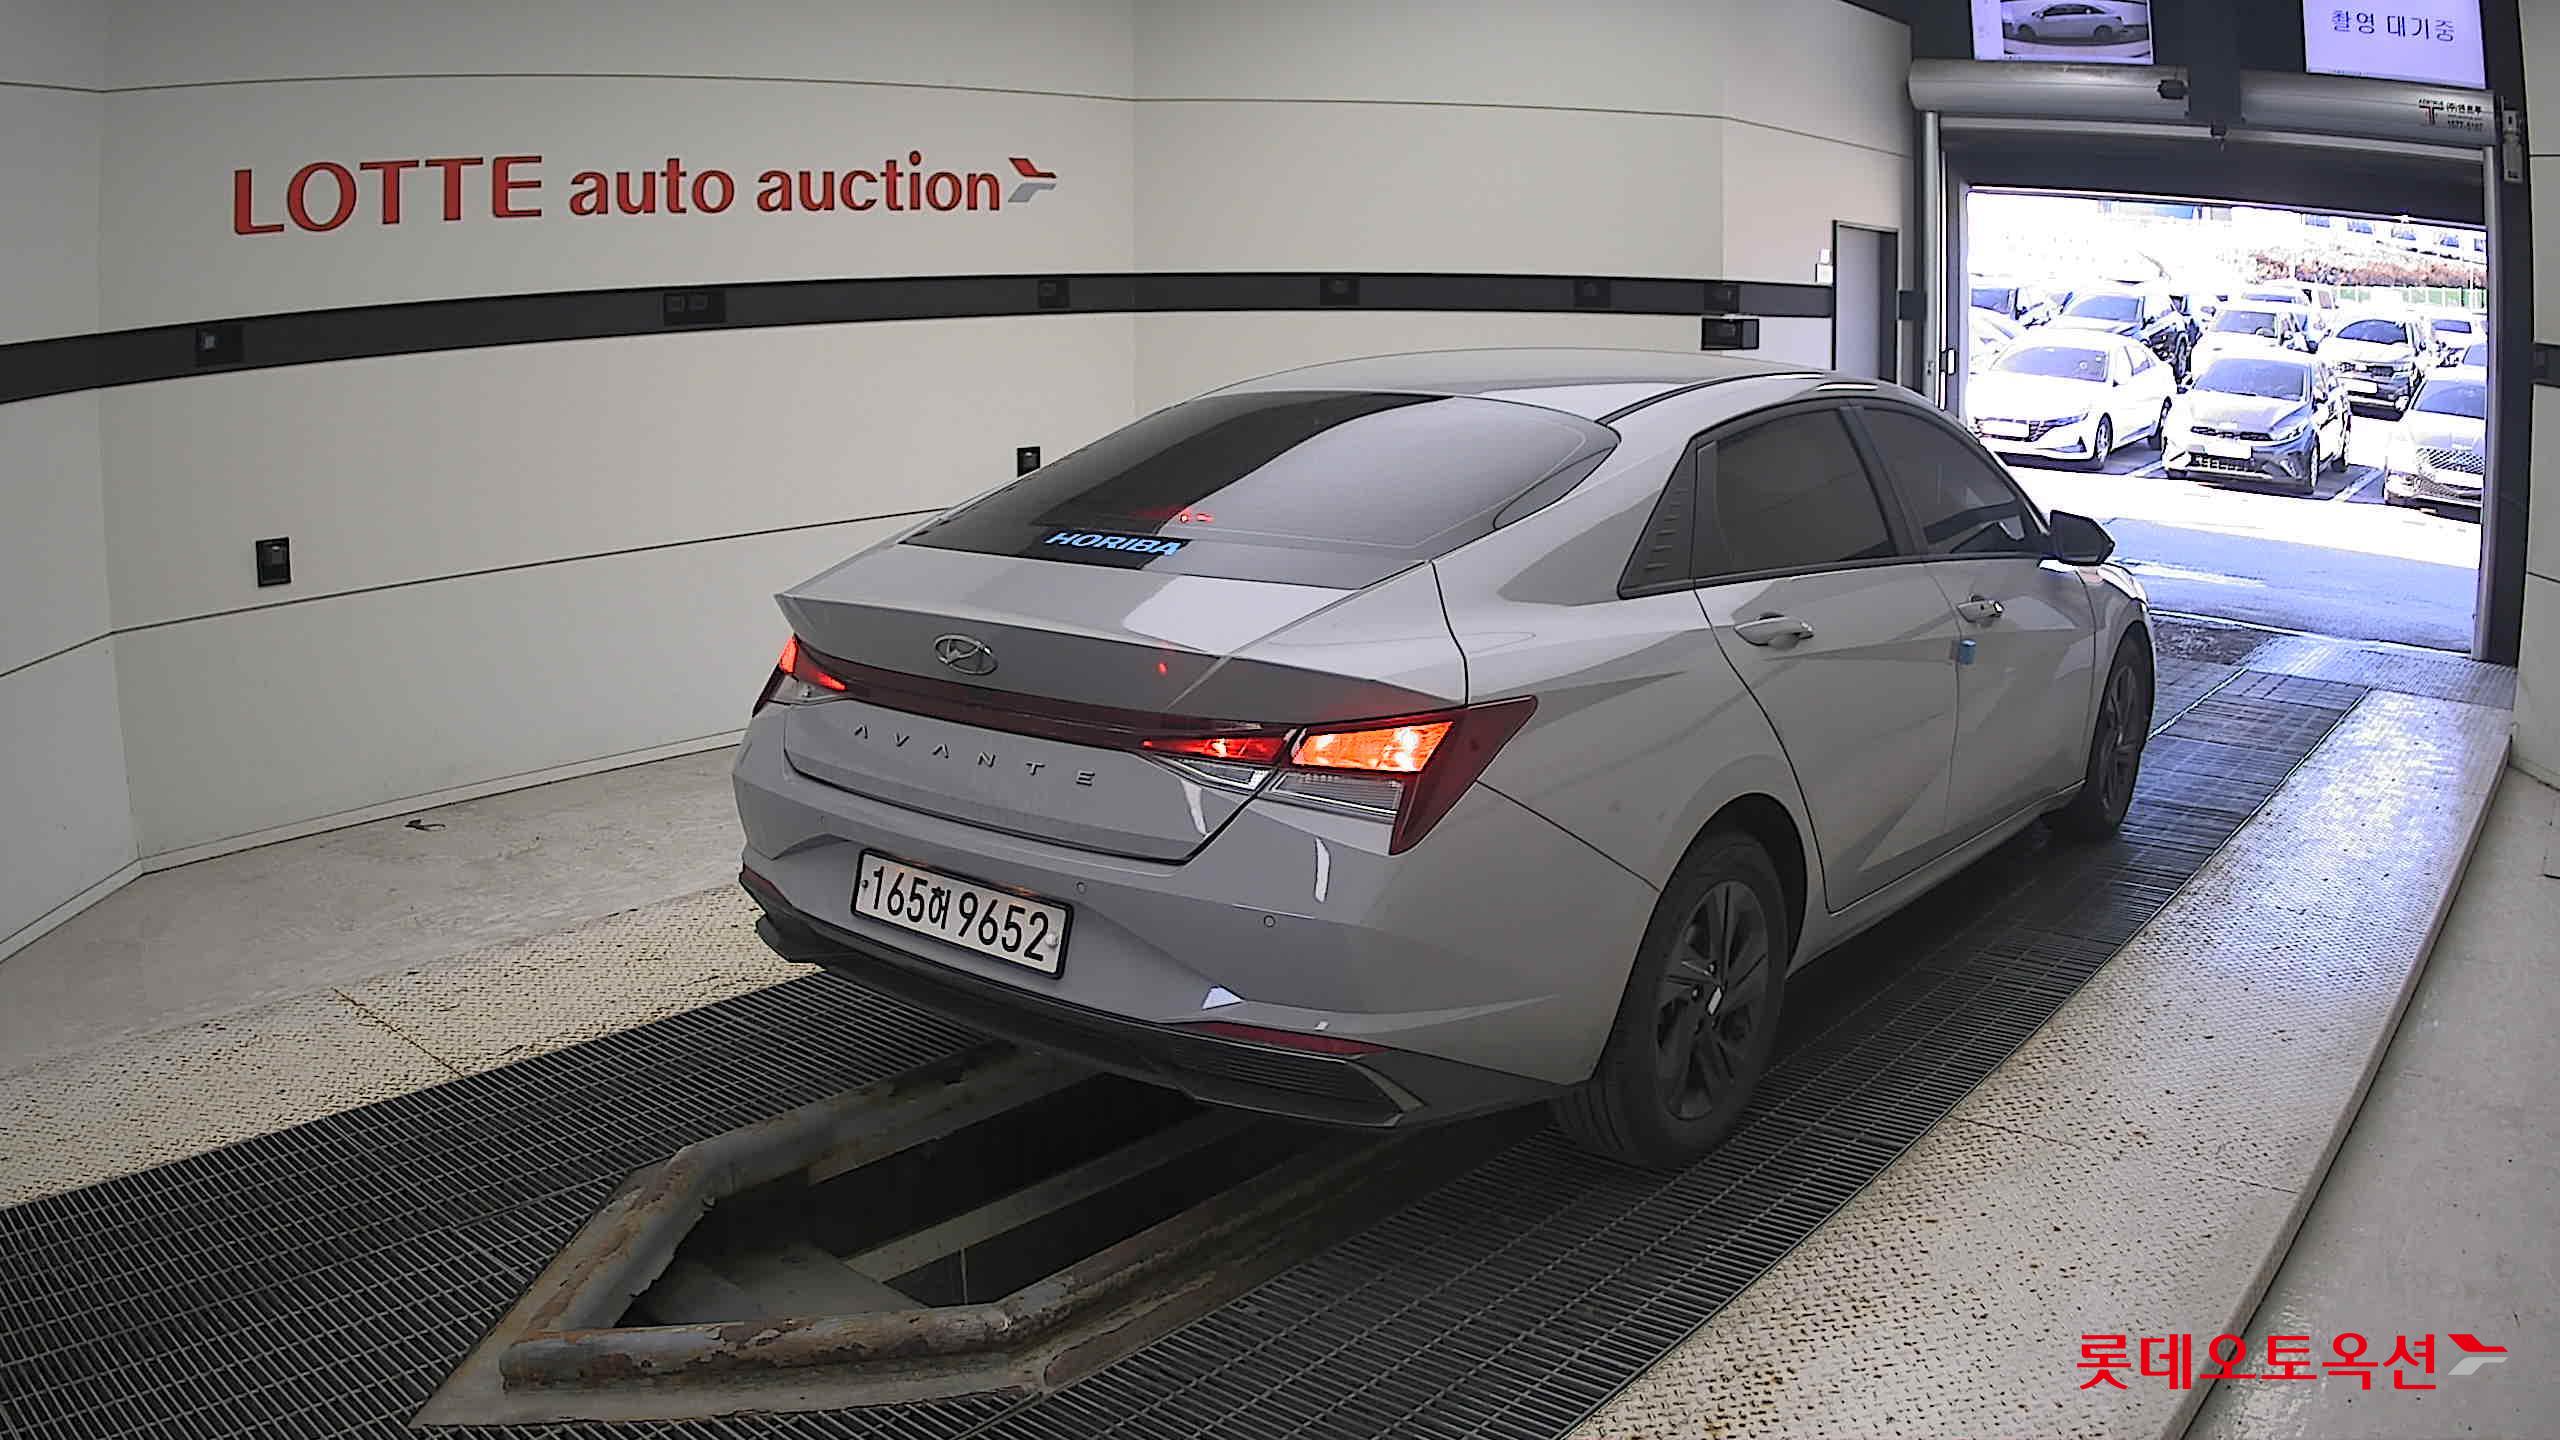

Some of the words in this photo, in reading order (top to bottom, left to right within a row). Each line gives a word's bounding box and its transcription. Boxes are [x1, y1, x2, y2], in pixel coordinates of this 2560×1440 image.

[2332, 10, 2375, 34] 촬영
[2386, 15, 2456, 42] 대기중
[233, 155, 543, 235] LOTTE
[569, 157, 735, 216] auto
[756, 150, 1001, 212] auction
[1045, 531, 1182, 556] HORIBA
[853, 723, 1096, 787] AVANTE
